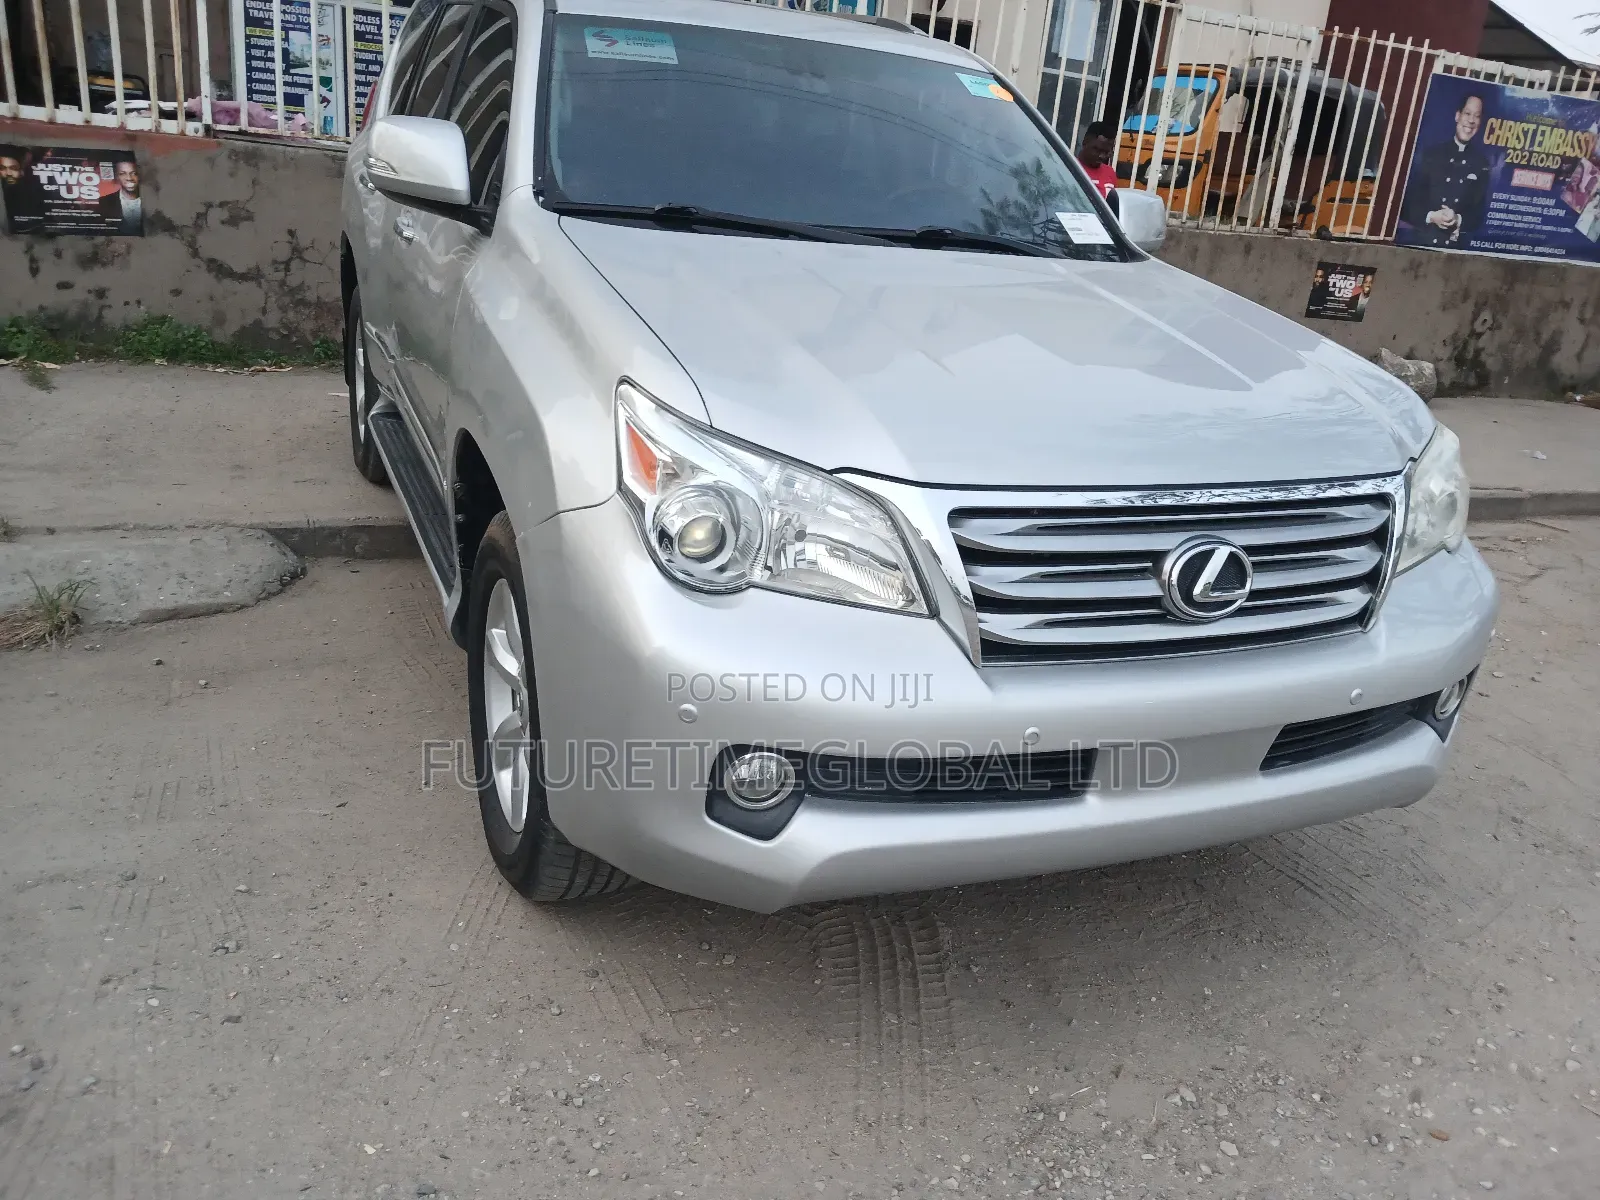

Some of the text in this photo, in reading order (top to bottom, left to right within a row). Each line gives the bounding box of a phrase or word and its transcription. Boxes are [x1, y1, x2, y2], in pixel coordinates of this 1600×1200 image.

[246, 1, 312, 14] ENDLES POSSIBI
[249, 9, 275, 19] TRAVE
[299, 15, 312, 23] TO
[354, 14, 381, 25] NDLESS
[354, 23, 379, 33] RAVEL
[251, 72, 275, 80] CANADA
[281, 74, 293, 82] ORK
[251, 83, 276, 91] CANADA
[1483, 117, 1596, 159] CHRIST EMBASSY
[1505, 149, 1562, 169] 202 ROAD
[31, 163, 72, 171] JUST
[33, 170, 100, 186] TWO
[60, 185, 100, 200] US
[1492, 192, 1510, 200] EVERY
[1490, 201, 1508, 209] EVERY
[1480, 241, 1494, 249] CALL
[1328, 279, 1356, 289] TWO
[1335, 289, 1353, 298] US
